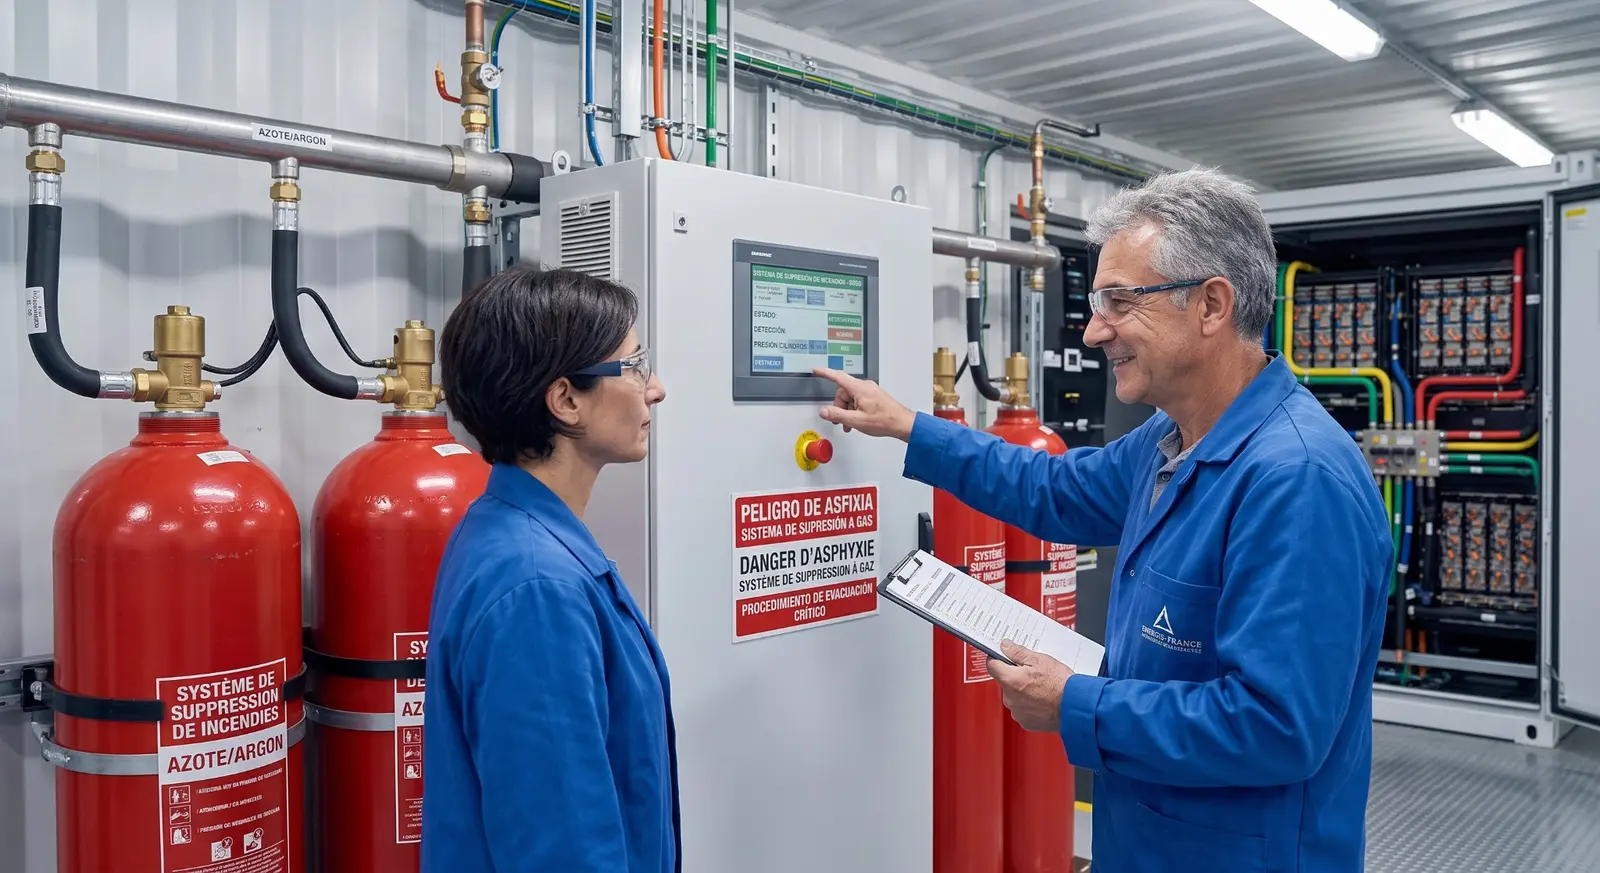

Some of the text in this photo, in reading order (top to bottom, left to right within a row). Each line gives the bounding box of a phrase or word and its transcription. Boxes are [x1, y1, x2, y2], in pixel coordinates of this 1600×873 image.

[259, 128, 326, 146] AZOTE/ARGON
[754, 310, 778, 319] ESTADO:
[741, 493, 874, 523] PELIGRO DE ASFIXIA
[741, 514, 873, 541] SISTEMA DE SUPRESIÓN A GAS
[740, 540, 875, 575] DANGER D'ASPHYXIE
[739, 561, 875, 592] SYSTÈME DE SUPPRESSION À GAZ
[741, 582, 873, 616] PROCEDIMIENTO DE EVACUACIÓN
[794, 605, 826, 621] CRÍTICO
[177, 671, 275, 702] SYSTÈME DE
[171, 687, 279, 721] SUPPRESSION
[172, 705, 279, 740] DE INCENDIES
[167, 733, 283, 773] AZOTE/ARGON
